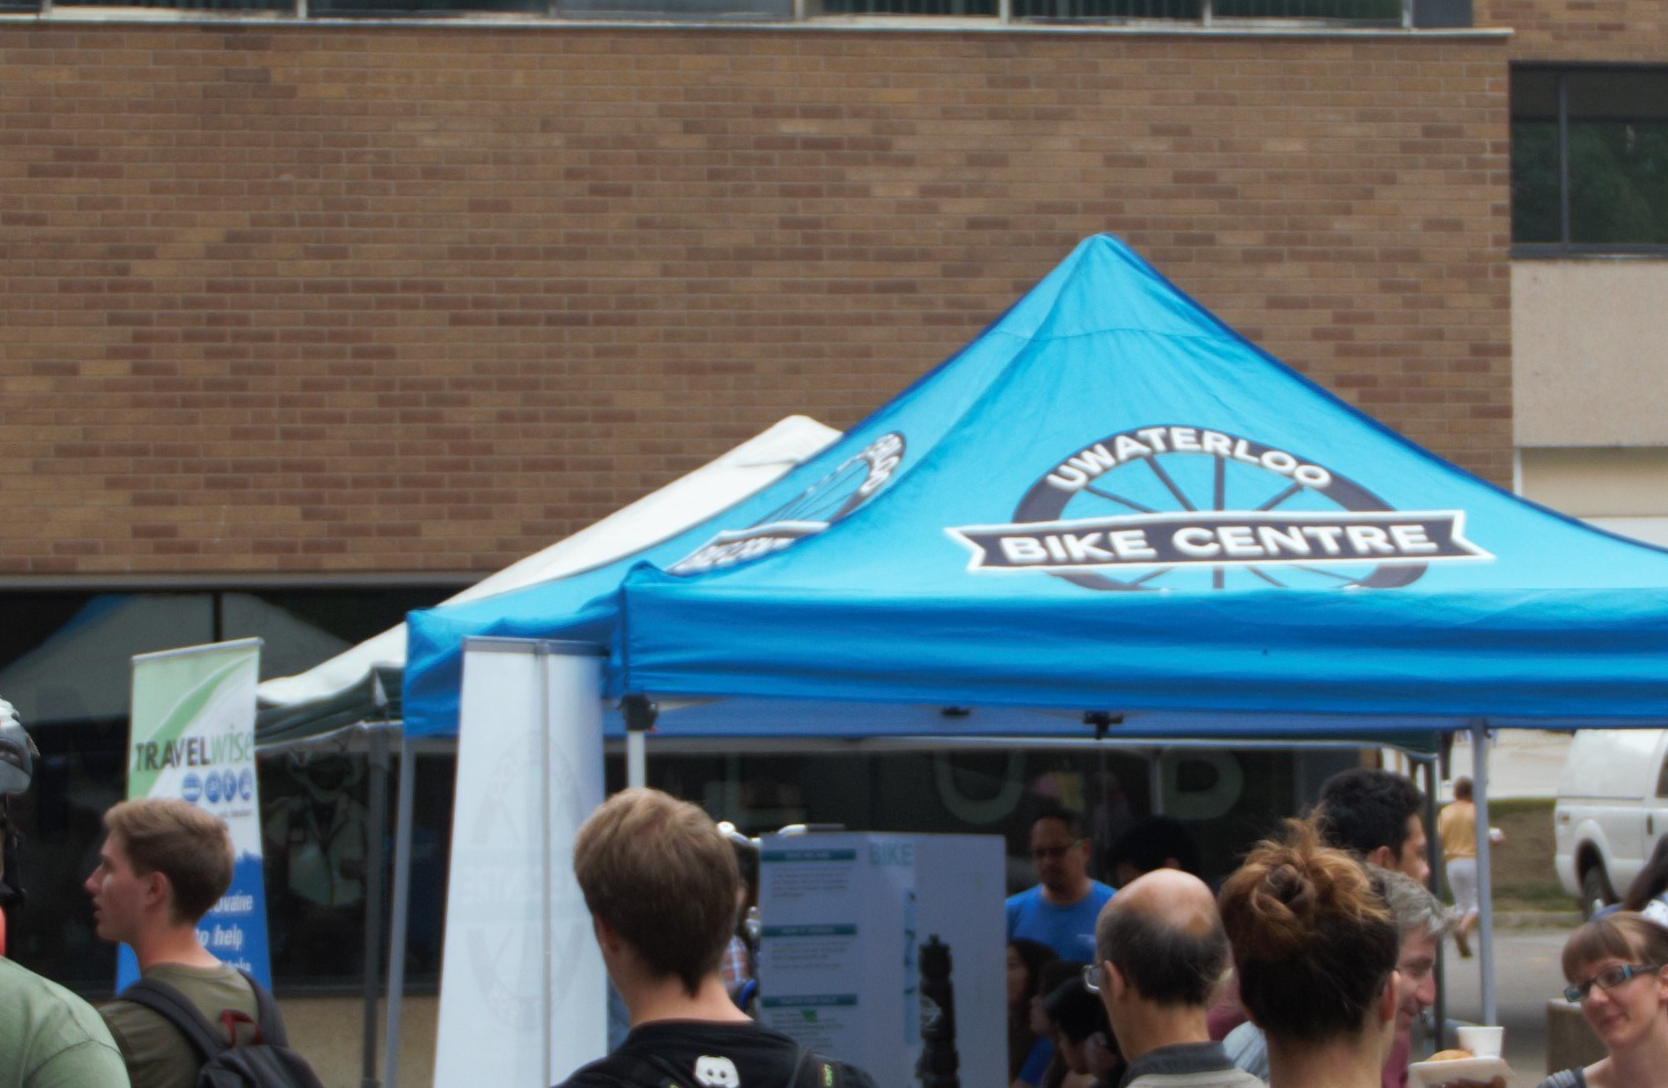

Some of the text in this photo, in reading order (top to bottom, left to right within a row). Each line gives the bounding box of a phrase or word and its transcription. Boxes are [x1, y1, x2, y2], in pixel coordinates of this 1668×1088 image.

[1046, 427, 1332, 492] UWATERLOO
[998, 523, 1438, 564] BIKE CENTRE
[213, 924, 243, 951] help
